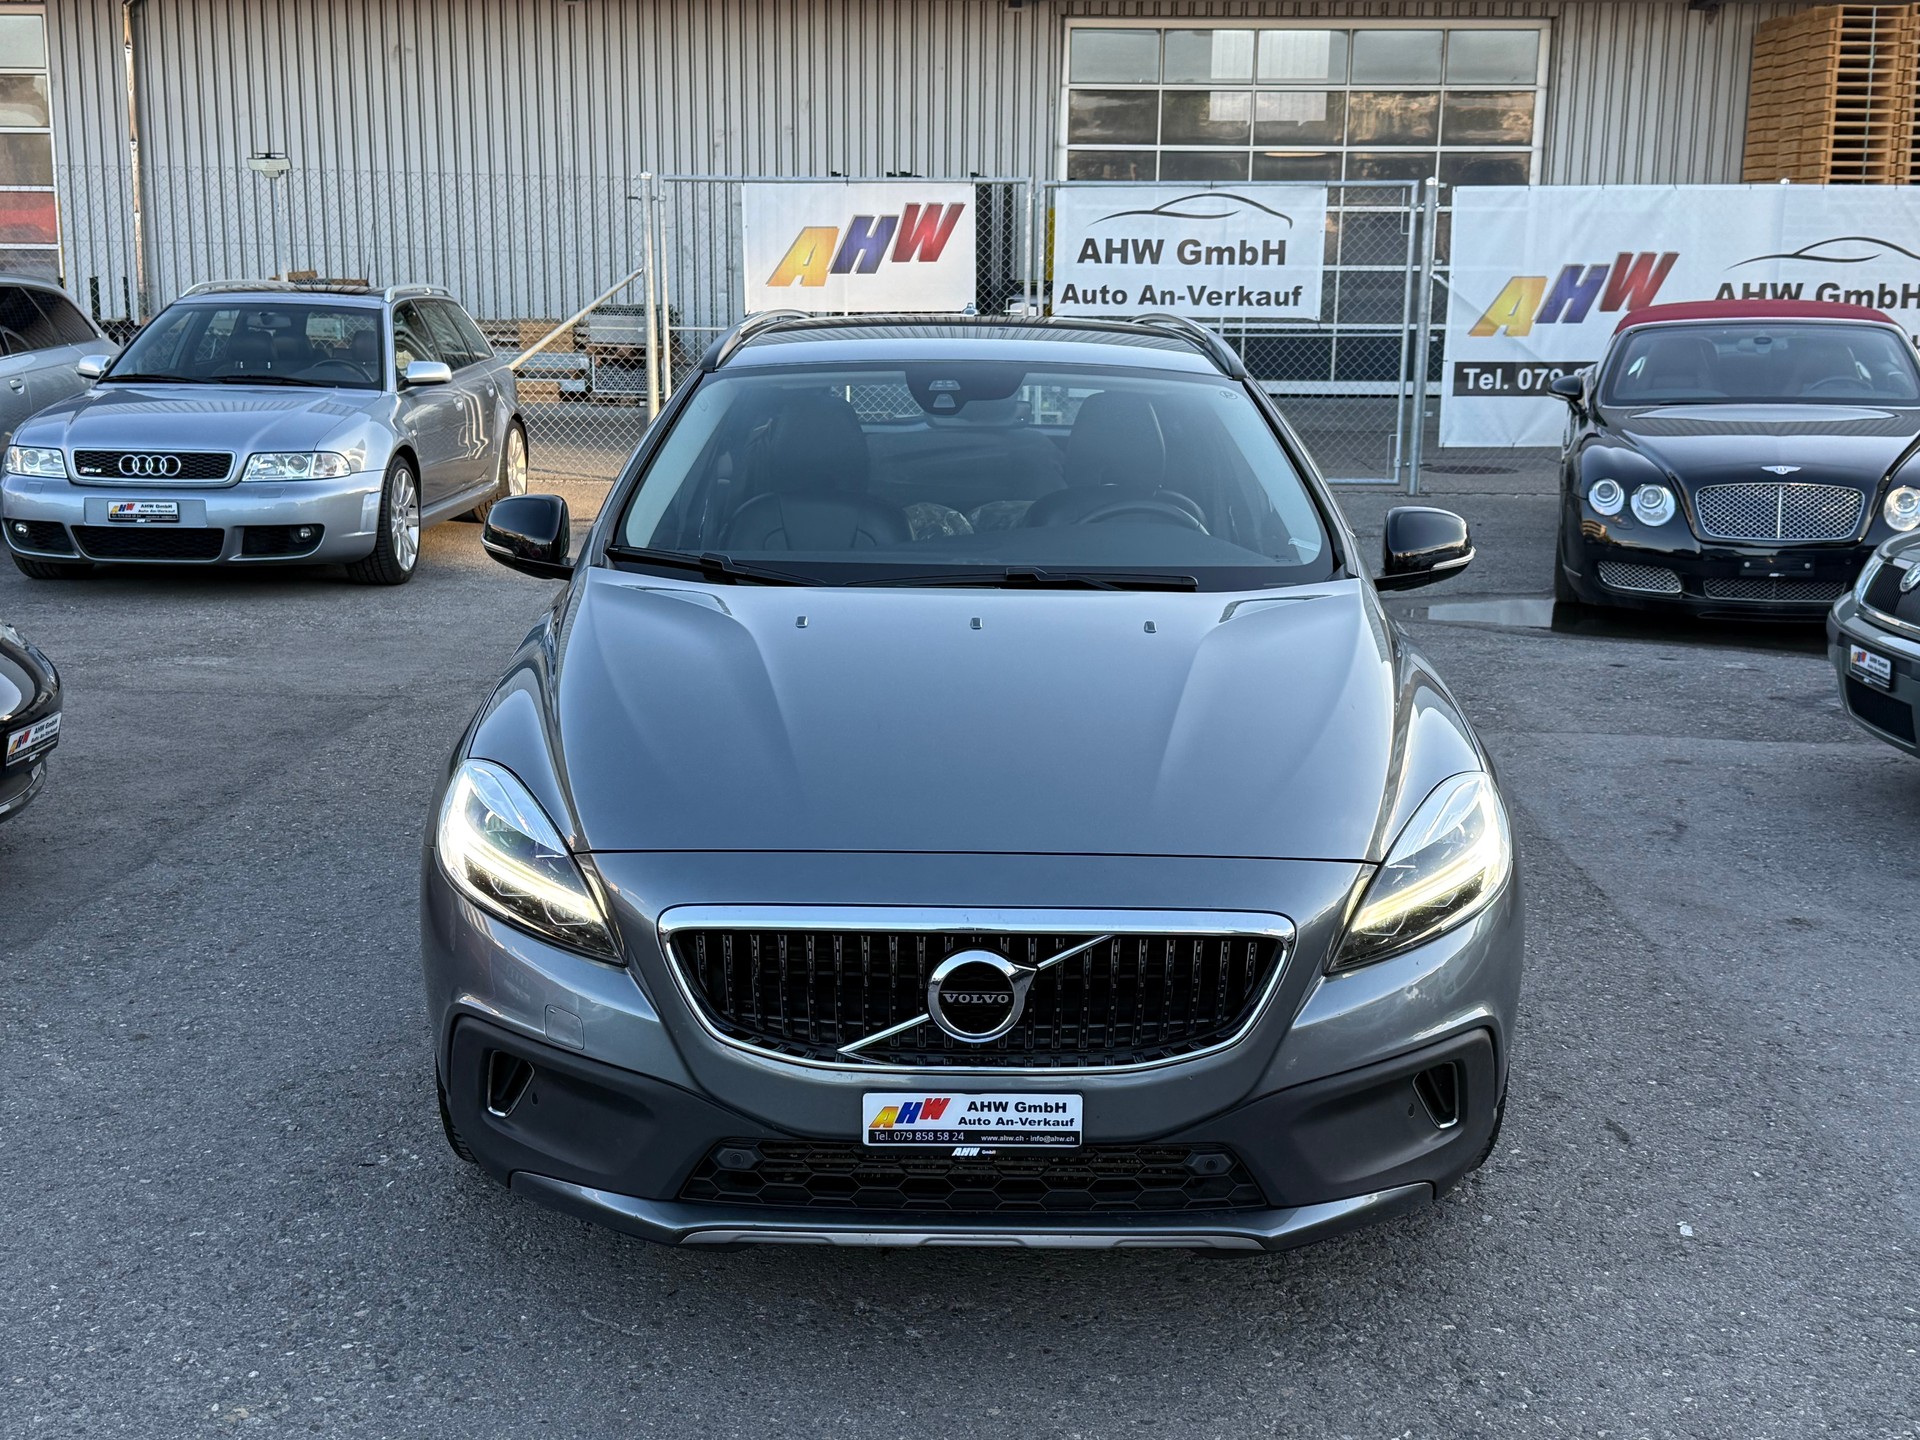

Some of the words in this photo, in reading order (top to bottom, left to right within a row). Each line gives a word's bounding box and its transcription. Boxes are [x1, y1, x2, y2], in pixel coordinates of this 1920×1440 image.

[766, 202, 966, 287] AHW
[1077, 238, 1165, 264] AHW
[1177, 238, 1287, 265] GmbH
[1060, 283, 1128, 305] Auto
[1138, 284, 1303, 307] An-Verkauf
[1468, 252, 1680, 336] AHW
[1715, 282, 1804, 301] AHW
[1815, 282, 1920, 309] GmbH
[1463, 368, 1509, 390] Tel.
[943, 993, 1010, 1004] VOLVO
[869, 1098, 951, 1128] AHW
[967, 1101, 1009, 1113] AHW
[1014, 1101, 1067, 1113] GmbH
[958, 1116, 991, 1126] Auto
[995, 1116, 1075, 1127] An-Verkauf
[875, 1131, 891, 1141] Tel.
[893, 1131, 913, 1141] 079
[915, 1131, 934, 1141] 858
[937, 1131, 949, 1141] 58
[952, 1131, 965, 1141] 24
[952, 1147, 980, 1157] AHW
